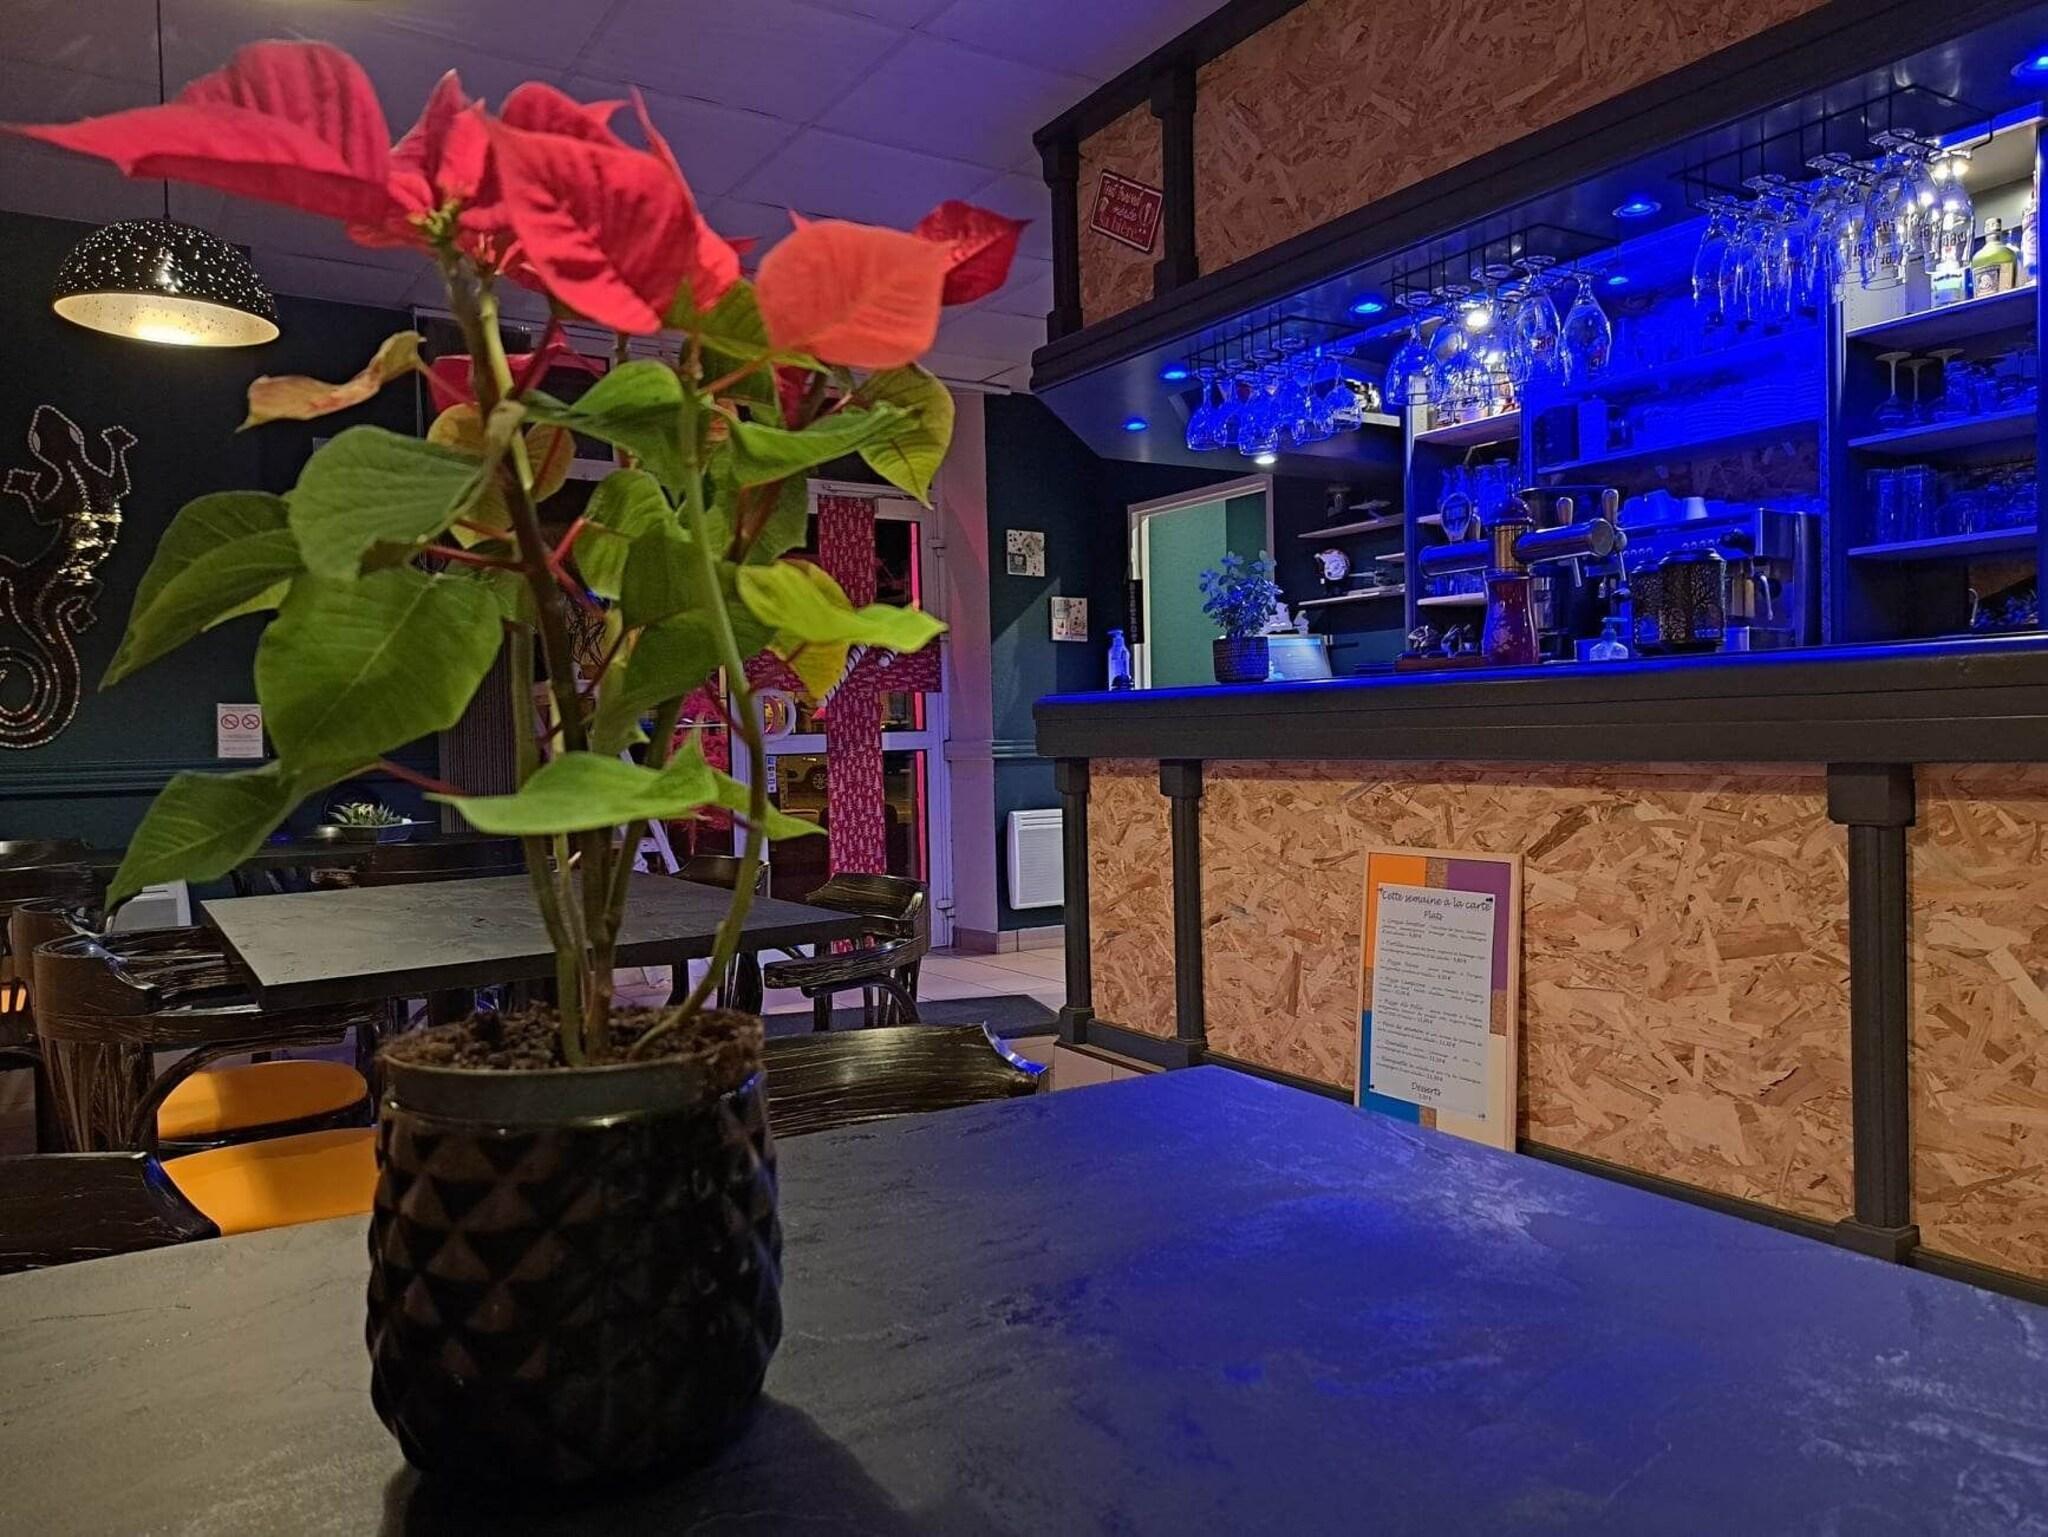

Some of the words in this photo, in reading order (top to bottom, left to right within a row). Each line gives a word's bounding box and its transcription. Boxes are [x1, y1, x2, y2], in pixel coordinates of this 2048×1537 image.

[1382, 890, 1402, 901] Cette
[1404, 894, 1442, 906] semaine
[1453, 897, 1465, 908] la
[1465, 901, 1492, 912] carte
[1424, 910, 1443, 921] Plats
[1411, 1082, 1441, 1097] Desserts
